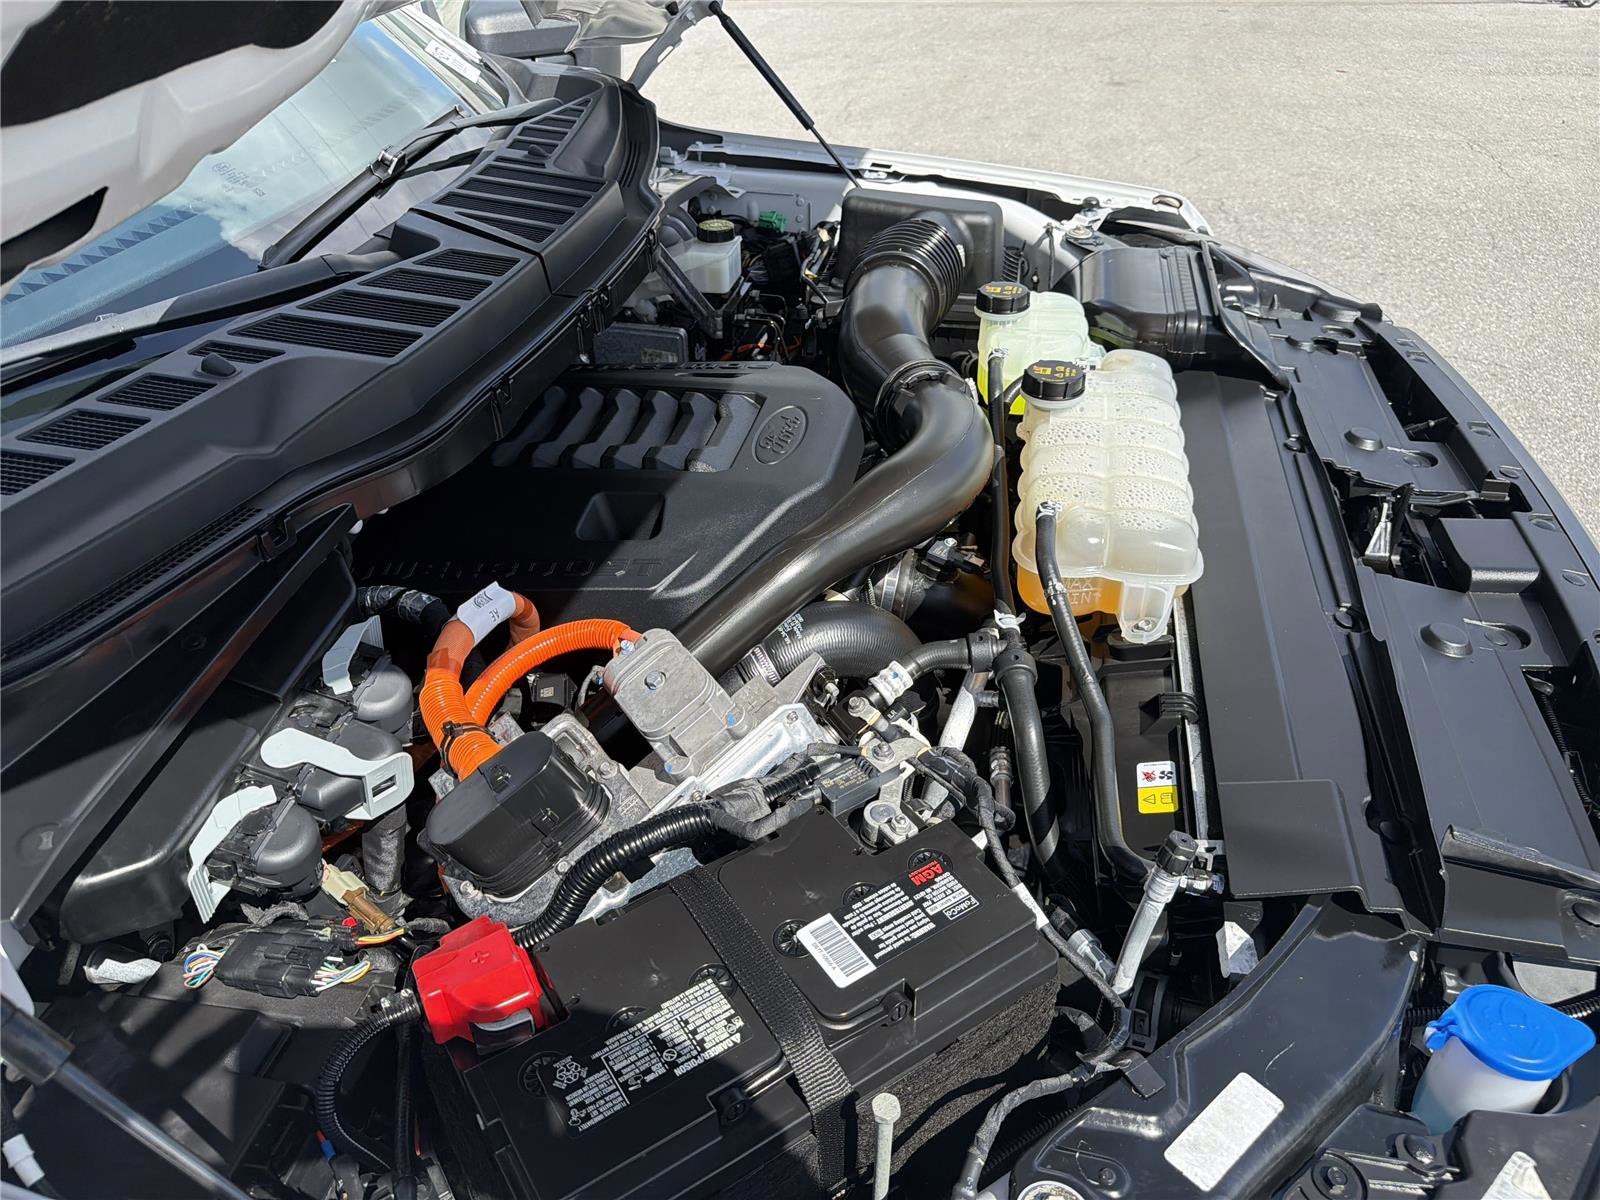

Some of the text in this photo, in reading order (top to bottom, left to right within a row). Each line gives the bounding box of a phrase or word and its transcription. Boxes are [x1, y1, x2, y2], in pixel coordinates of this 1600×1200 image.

[758, 414, 801, 455] Ford
[906, 859, 937, 878] TECHNOLOGY
[910, 862, 944, 886] AGM
[944, 897, 976, 917] FoMoCo
[672, 1038, 734, 1076] DANGER/POISON
